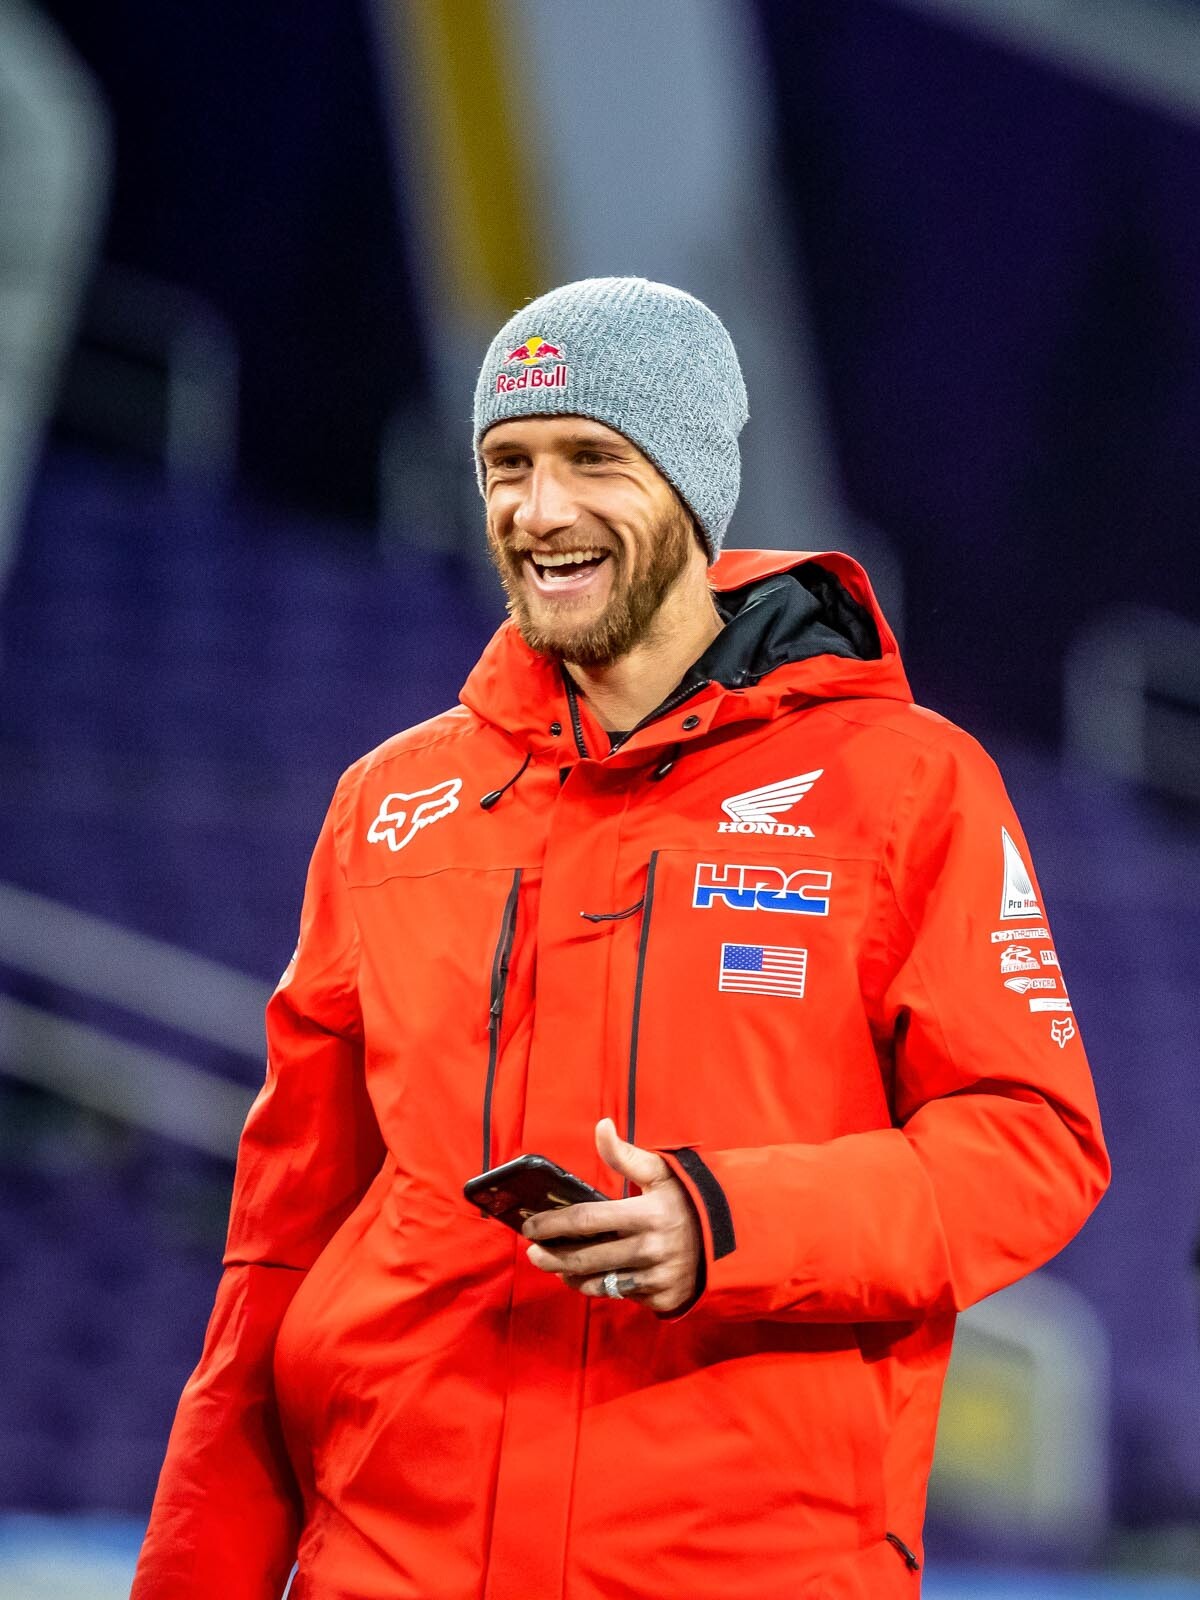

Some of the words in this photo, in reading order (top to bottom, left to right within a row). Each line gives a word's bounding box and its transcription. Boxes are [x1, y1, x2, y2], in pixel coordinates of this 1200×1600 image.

[496, 368, 527, 393] Red
[531, 366, 567, 388] Bull
[717, 821, 815, 838] HONDA
[692, 862, 832, 917] HRC
[1008, 900, 1022, 909] Pro
